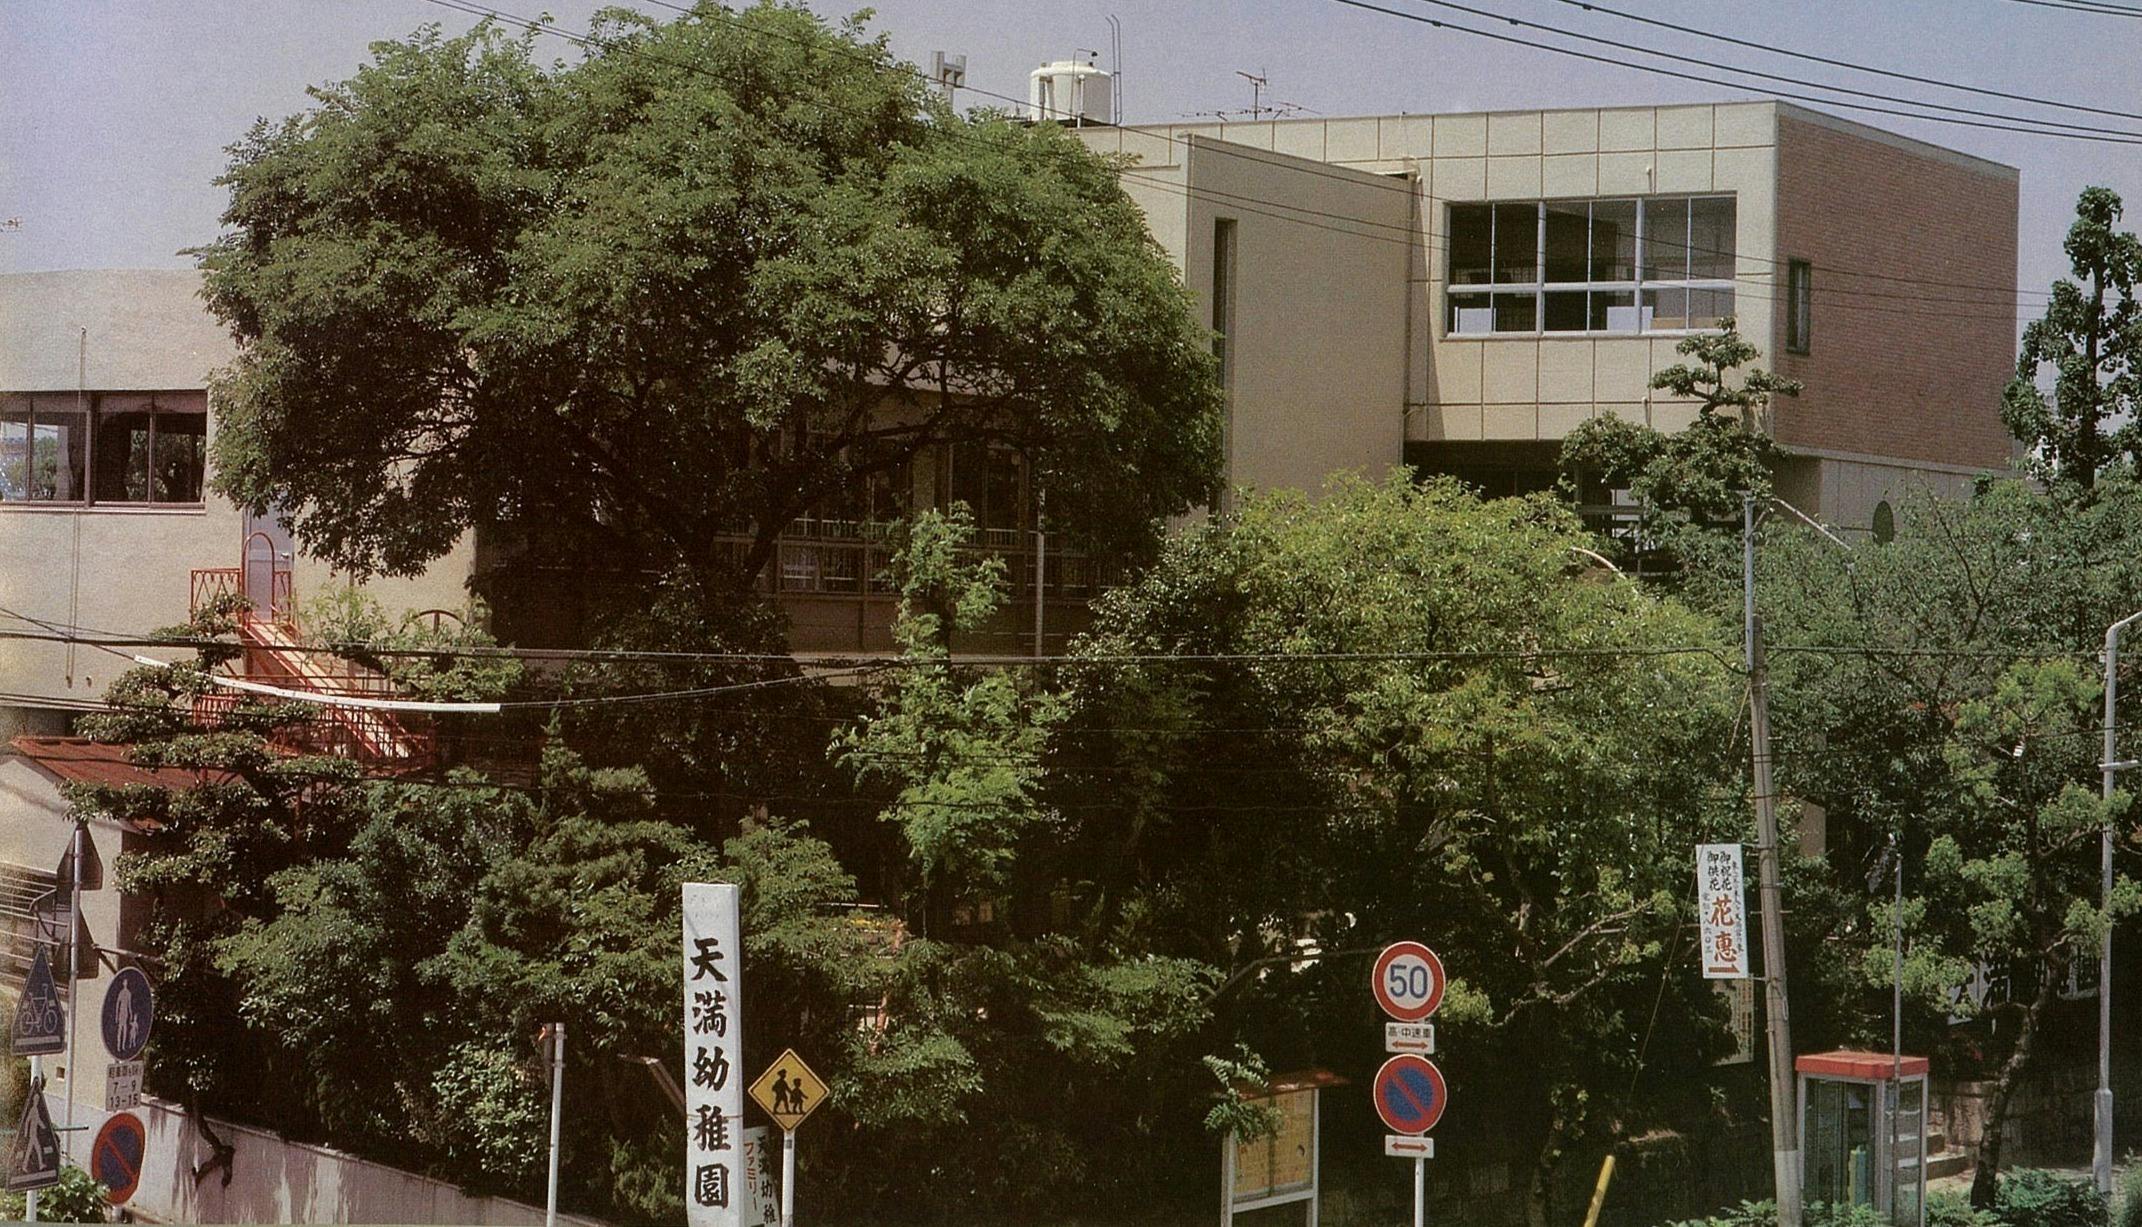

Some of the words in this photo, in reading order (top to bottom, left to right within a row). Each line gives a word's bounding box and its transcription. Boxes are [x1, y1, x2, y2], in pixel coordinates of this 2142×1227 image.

[1389, 964, 1428, 999] 50
[690, 937, 731, 1210] 天満幼稚園
